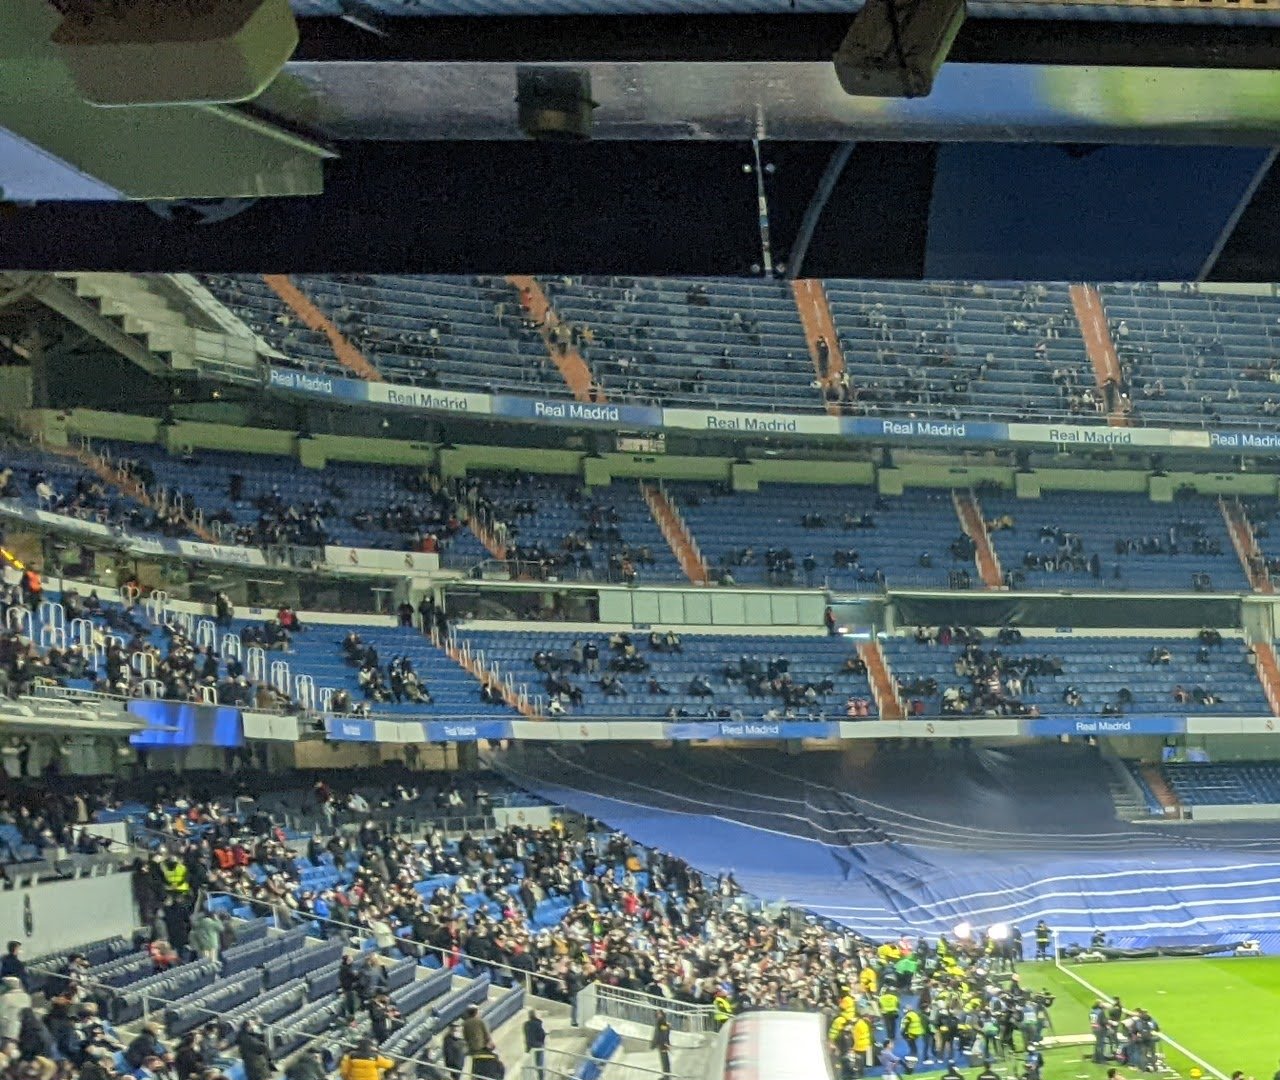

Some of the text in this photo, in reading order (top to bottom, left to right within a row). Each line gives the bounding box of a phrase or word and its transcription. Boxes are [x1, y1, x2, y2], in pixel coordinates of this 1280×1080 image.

[297, 373, 332, 393] Madrid
[388, 389, 468, 410] Real Madrid
[535, 402, 619, 422] Real Madrid
[707, 415, 797, 433] Real Madrid
[883, 420, 966, 437] Real Madrid
[1049, 428, 1132, 445] Real Madrid
[1211, 433, 1238, 447] Real
